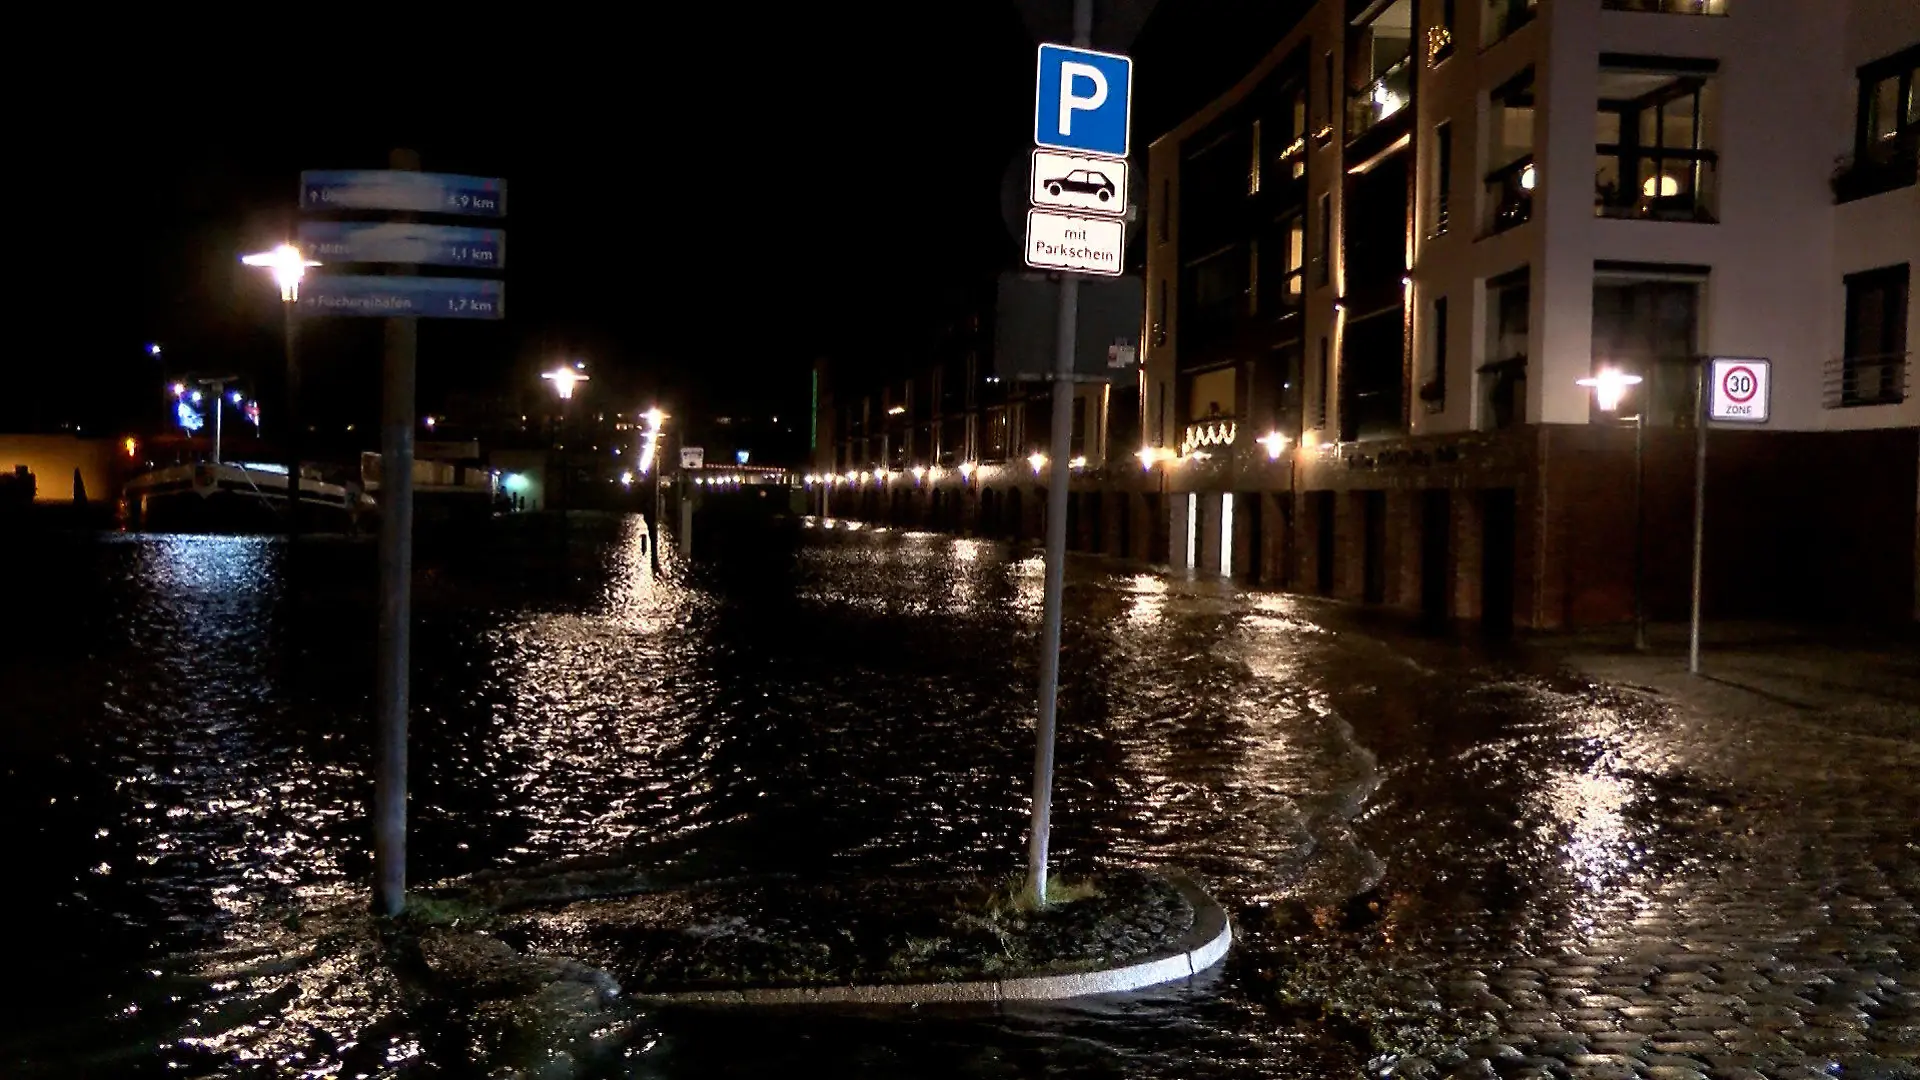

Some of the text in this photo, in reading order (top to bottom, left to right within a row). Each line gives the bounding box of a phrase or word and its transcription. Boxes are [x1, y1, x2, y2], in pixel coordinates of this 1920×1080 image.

[1058, 61, 1108, 136] P
[472, 195, 494, 209] km
[1064, 229, 1087, 241] mit
[451, 247, 467, 259] 1,1
[472, 248, 493, 260] km
[1036, 240, 1114, 262] Parkschein
[448, 299, 467, 311] 1,7
[471, 299, 492, 312] km
[1729, 375, 1751, 393] 30
[1725, 405, 1753, 415] ZONE
